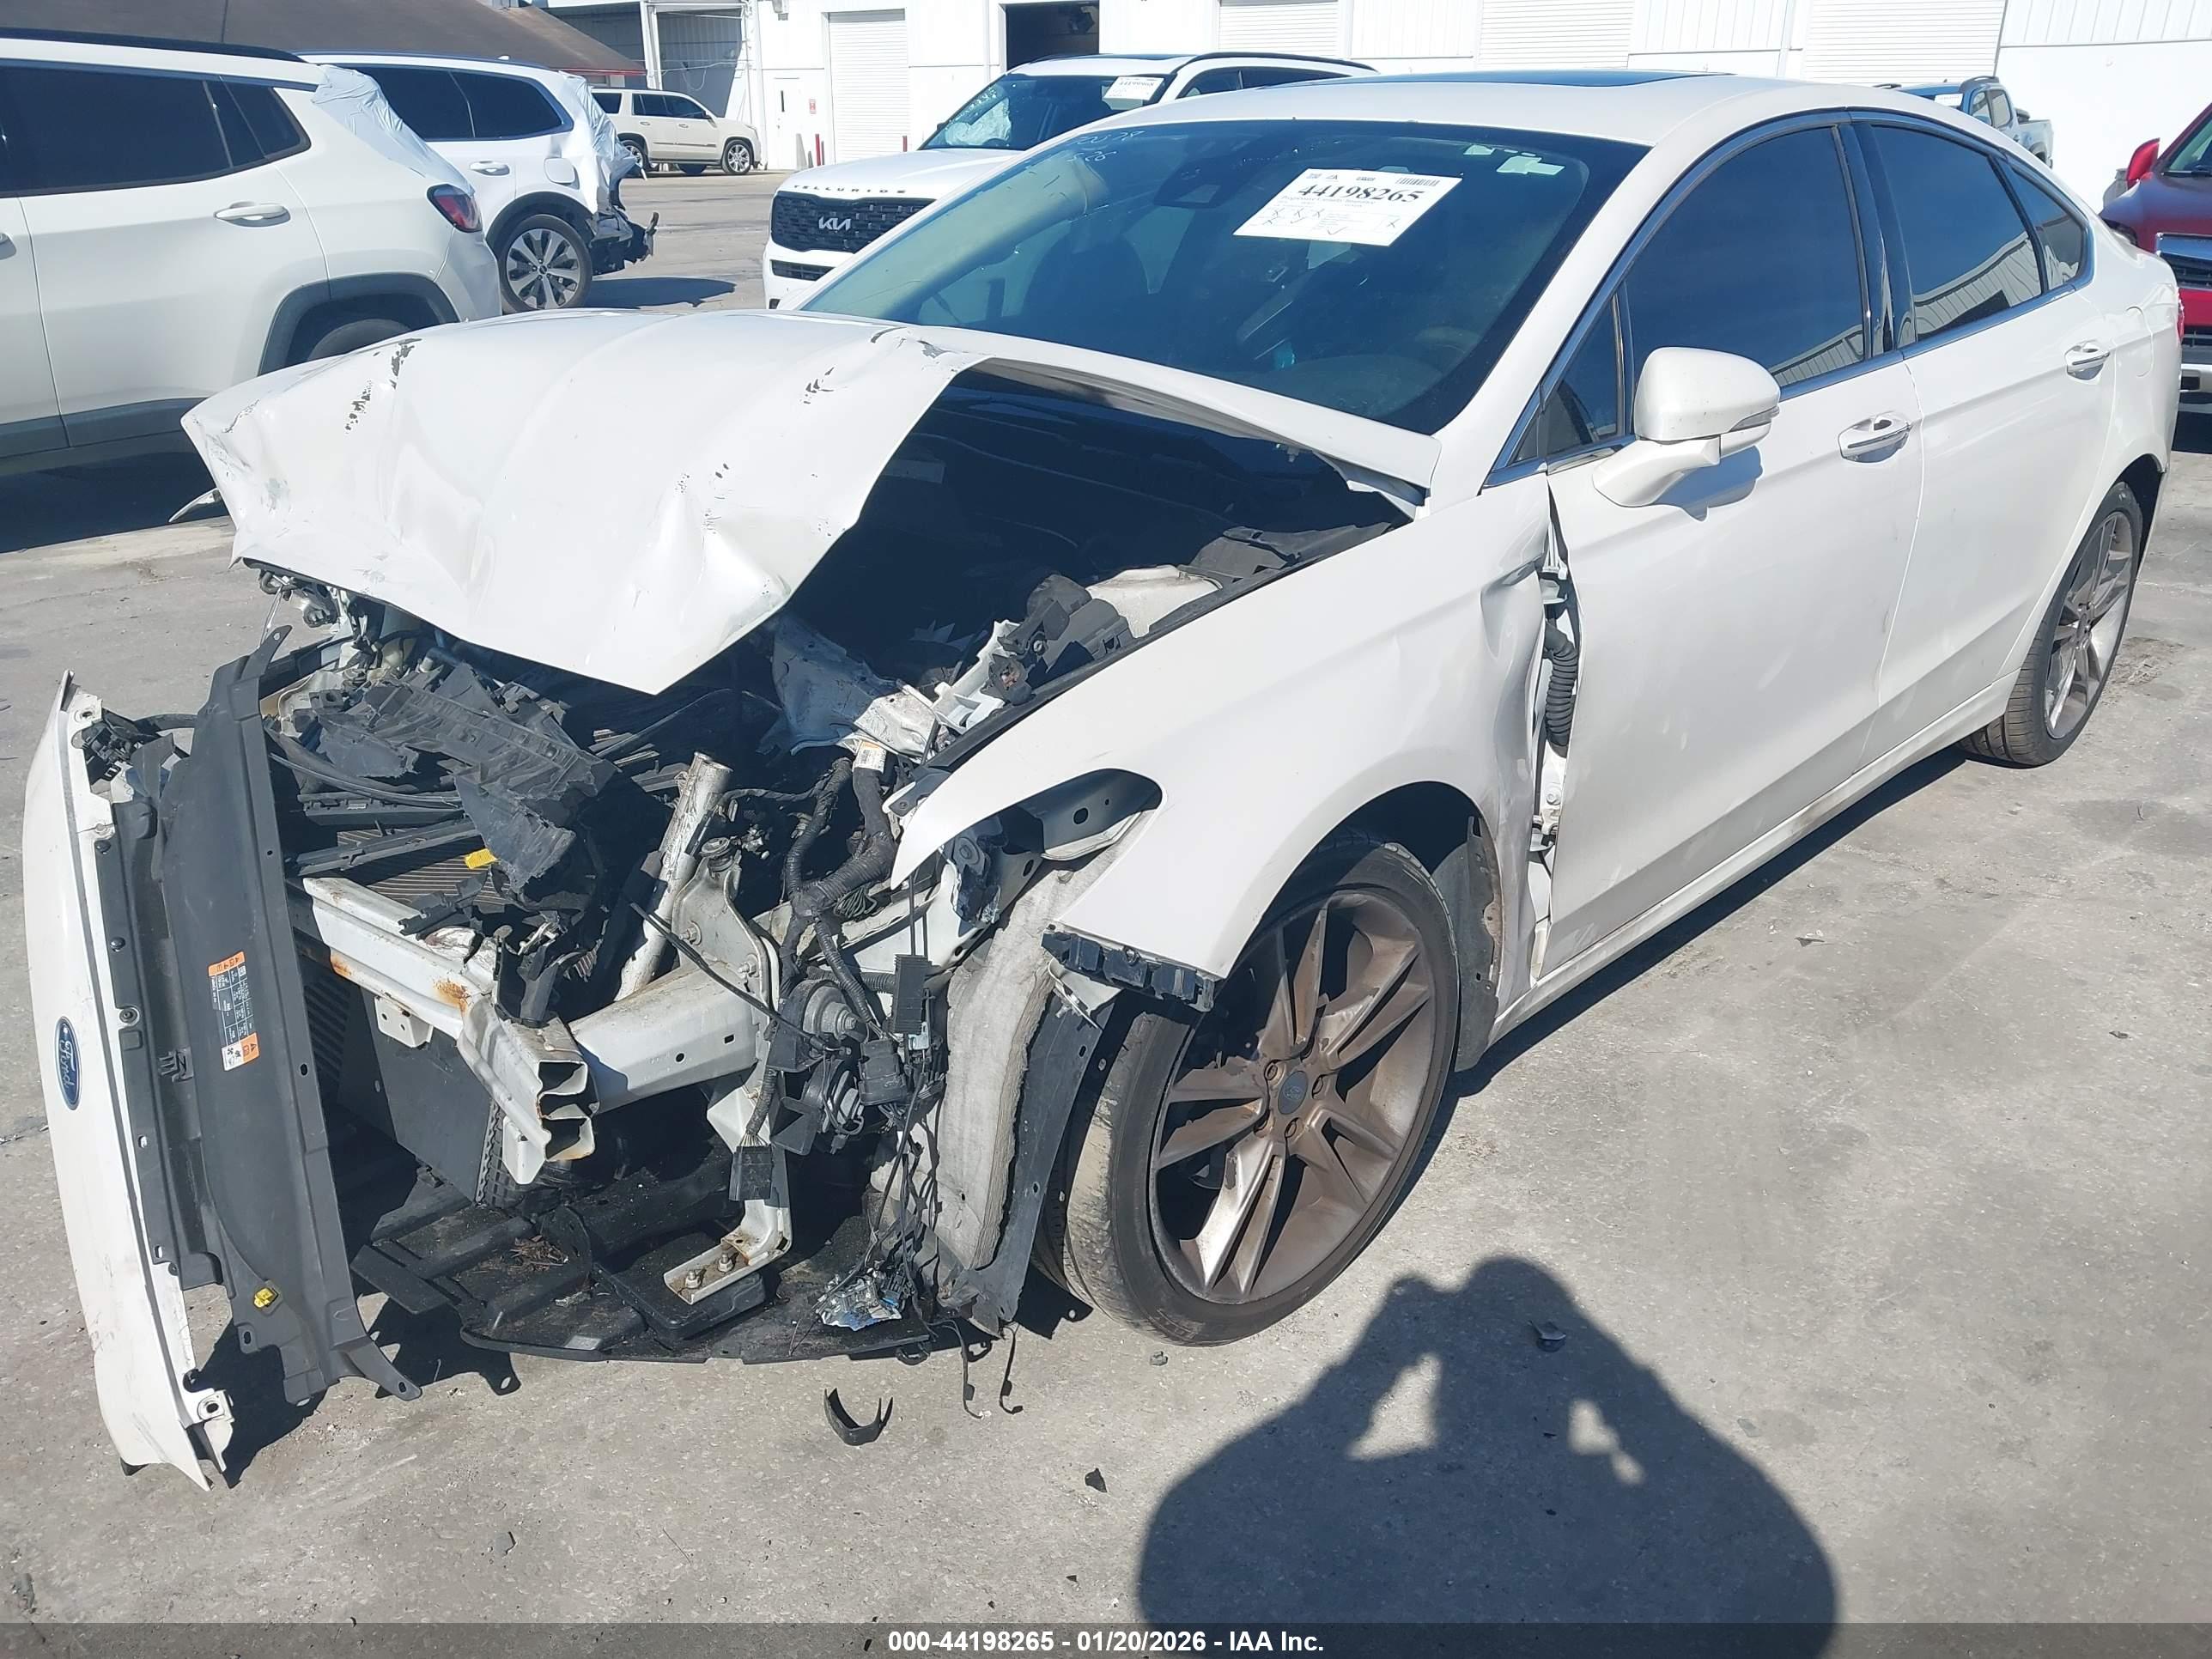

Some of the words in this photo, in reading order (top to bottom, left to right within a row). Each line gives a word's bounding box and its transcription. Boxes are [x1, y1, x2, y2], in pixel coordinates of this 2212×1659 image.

[793, 185, 907, 194] TELLURIDE
[1298, 184, 1425, 203] 44198265
[818, 216, 852, 231] KIA
[59, 1039, 76, 1089] Ford
